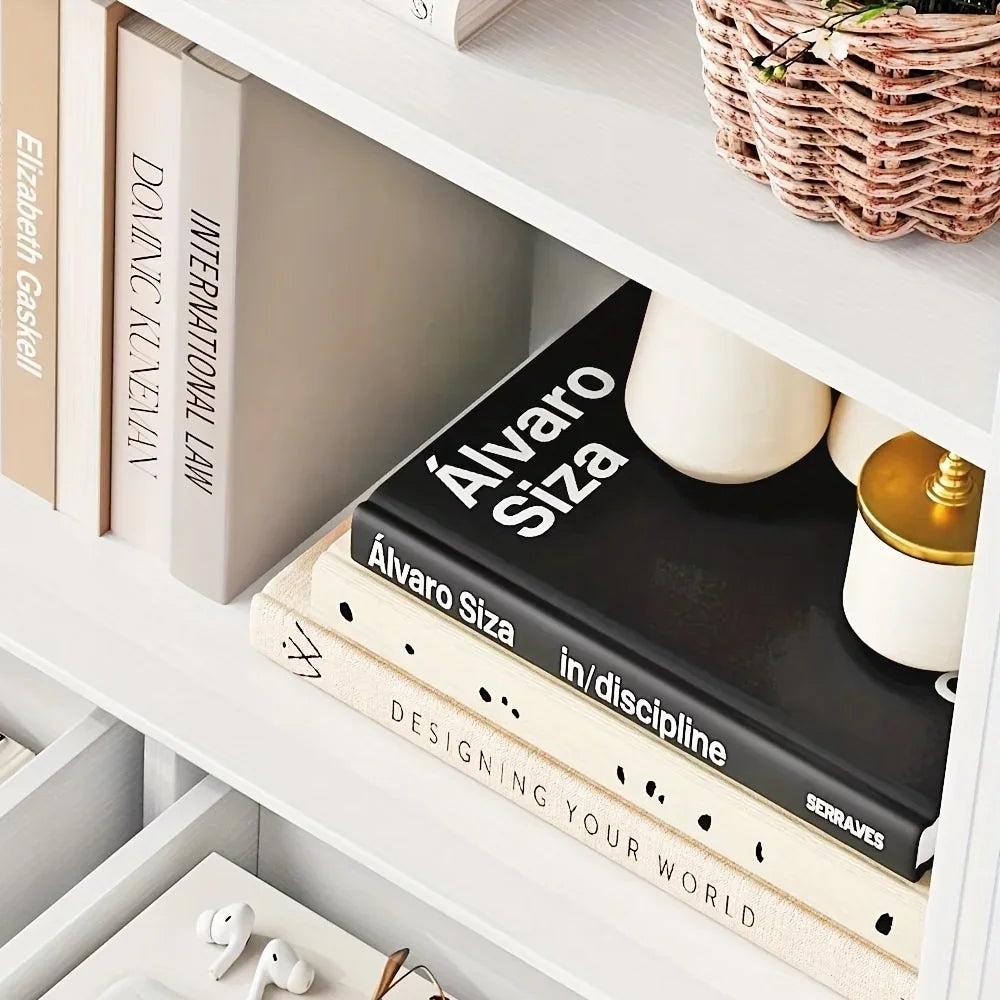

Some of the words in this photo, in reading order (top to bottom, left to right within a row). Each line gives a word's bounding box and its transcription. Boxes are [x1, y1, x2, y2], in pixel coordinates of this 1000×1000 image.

[16, 129, 43, 266] Elizabeth
[130, 152, 164, 305] DOMINIC
[16, 269, 43, 379] Gaskell
[186, 208, 221, 426] INTERNATIONAL
[128, 306, 162, 480] KUNEMAN
[425, 366, 615, 509] Álvaro
[184, 431, 215, 496] LAW
[492, 442, 630, 538] Siza
[367, 532, 453, 611] Álvaro
[458, 590, 515, 648] Siza
[559, 645, 728, 768] in/discipline
[391, 699, 547, 807] DESIGNING
[566, 799, 639, 863] YOUR
[657, 854, 756, 929] WORLD
[805, 792, 885, 851] SERRAVES
